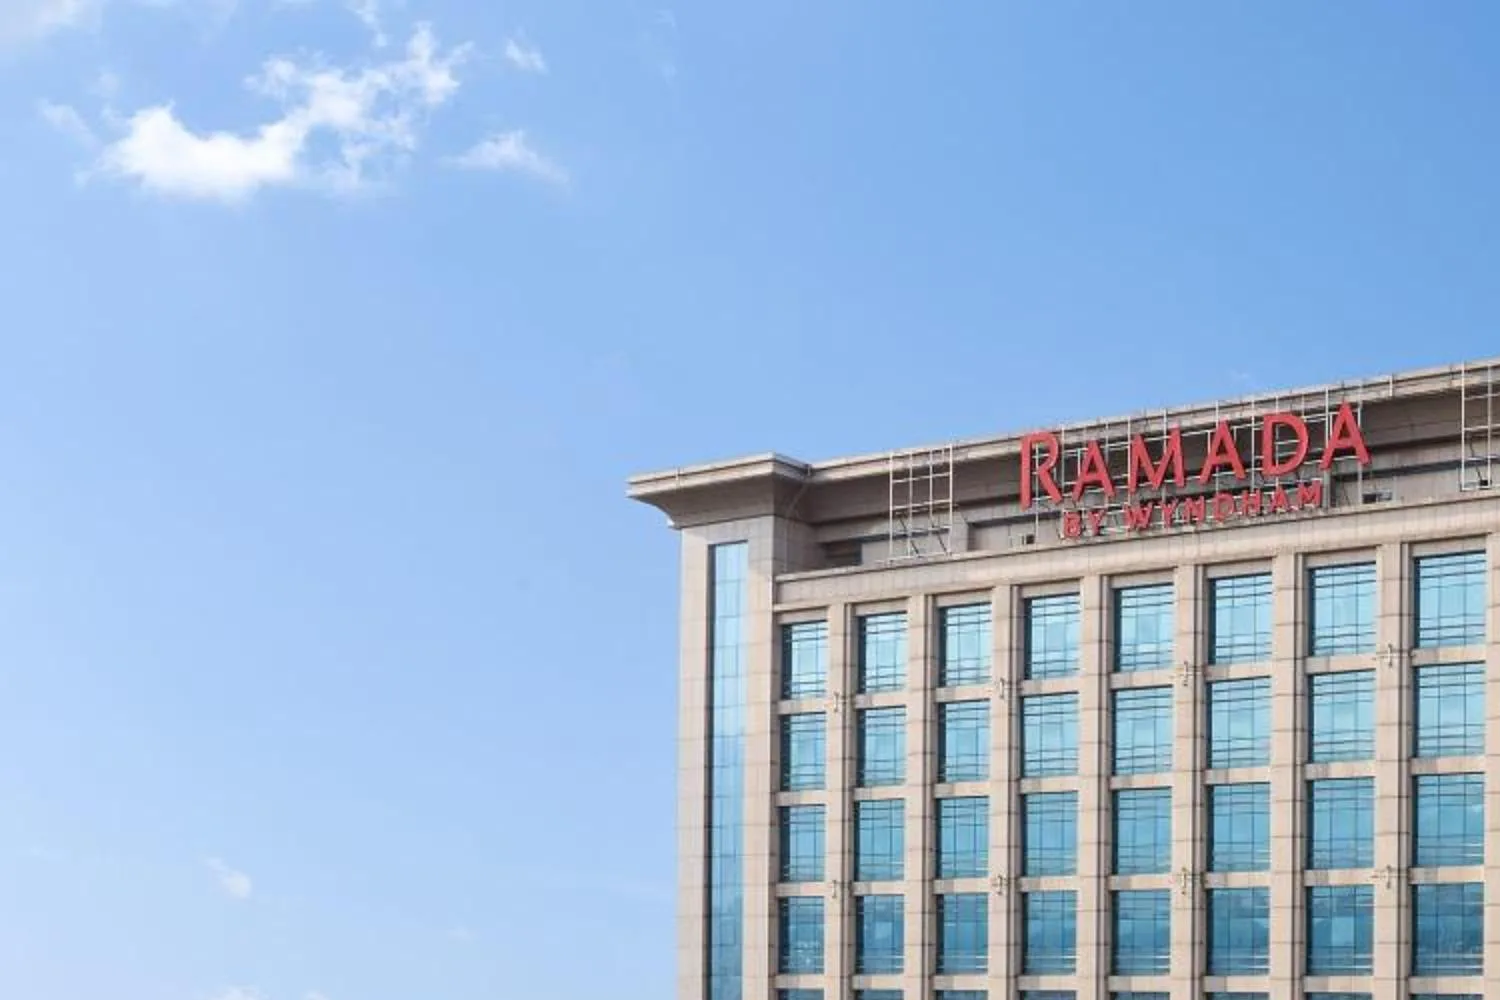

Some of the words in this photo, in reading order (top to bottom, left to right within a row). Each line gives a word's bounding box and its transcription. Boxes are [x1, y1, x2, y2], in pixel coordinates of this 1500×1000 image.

[1019, 402, 1371, 510] RAMADA
[1062, 511, 1105, 538] BY
[1124, 480, 1322, 532] WYNDHAM
